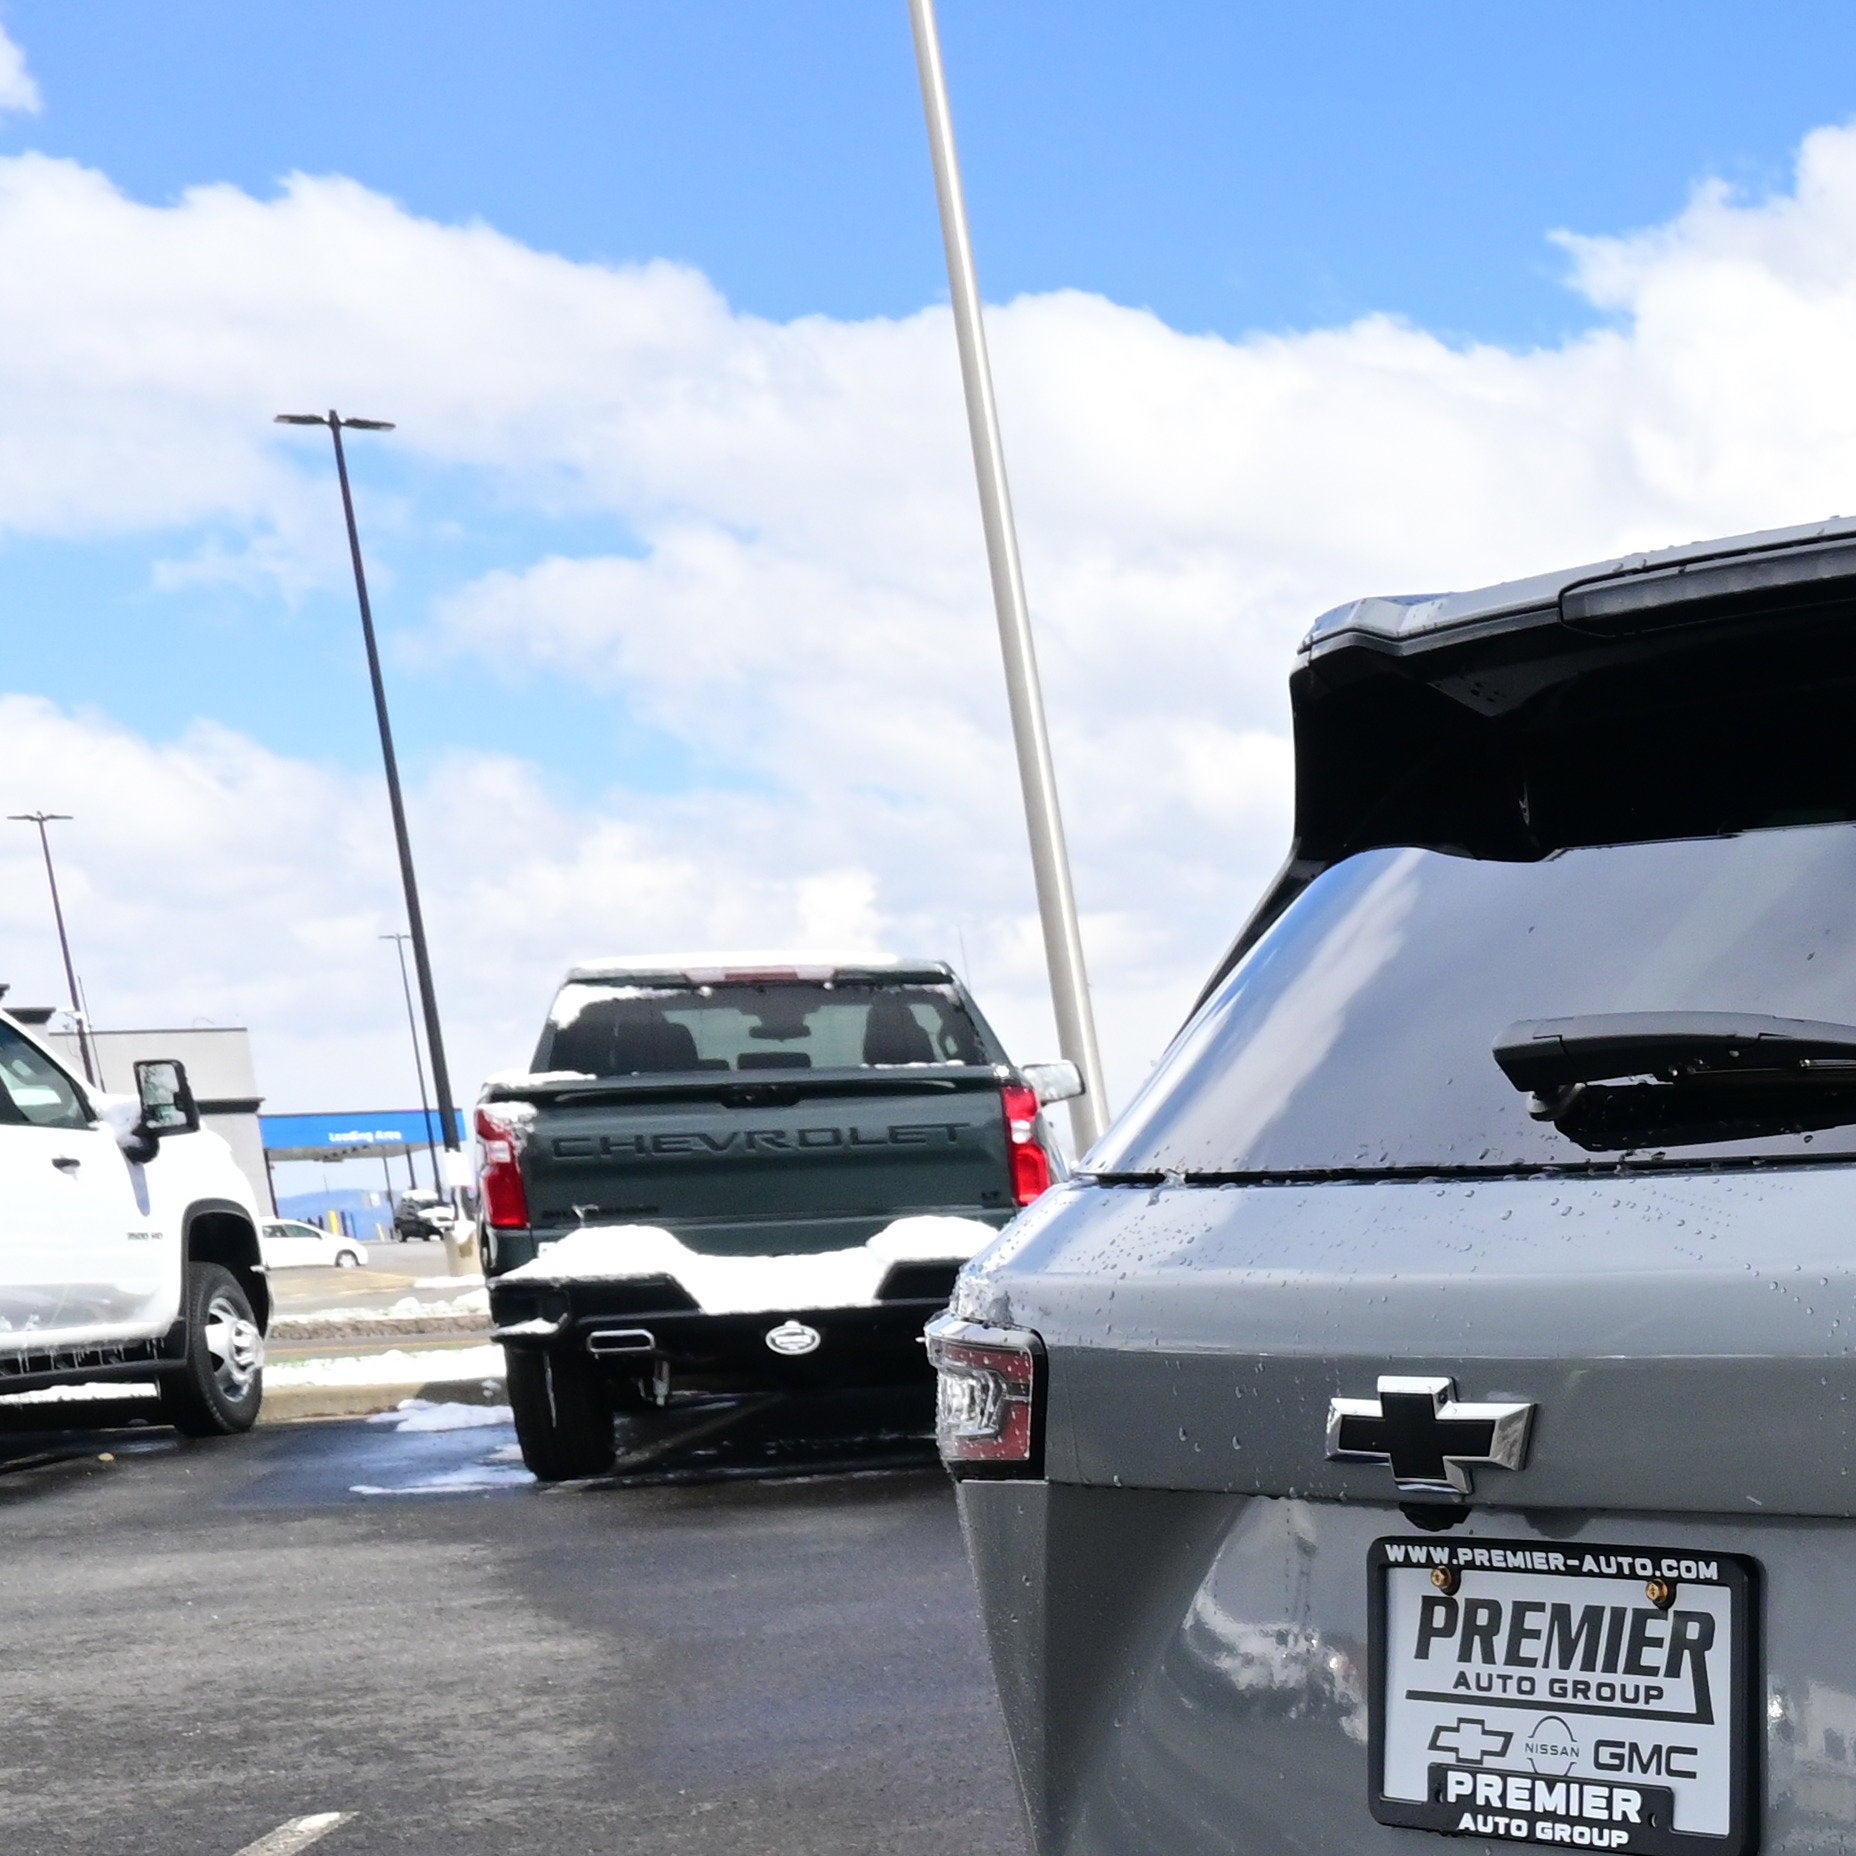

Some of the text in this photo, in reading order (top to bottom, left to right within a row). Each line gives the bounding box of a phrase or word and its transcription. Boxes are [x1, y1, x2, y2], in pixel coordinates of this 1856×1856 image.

[375, 1130, 402, 1140] Area
[551, 1122, 970, 1160] CHEVROLET
[1384, 1543, 1719, 1581] WWW.PREMIER-AUTO.COM
[1413, 1595, 1715, 1690] PREMIER
[1452, 1670, 1665, 1706] AUTO GROUP
[1524, 1738, 1699, 1780] NISSAN GMC
[1446, 1772, 1643, 1825] PREMIER
[1457, 1812, 1630, 1849] AUTO GROUP
